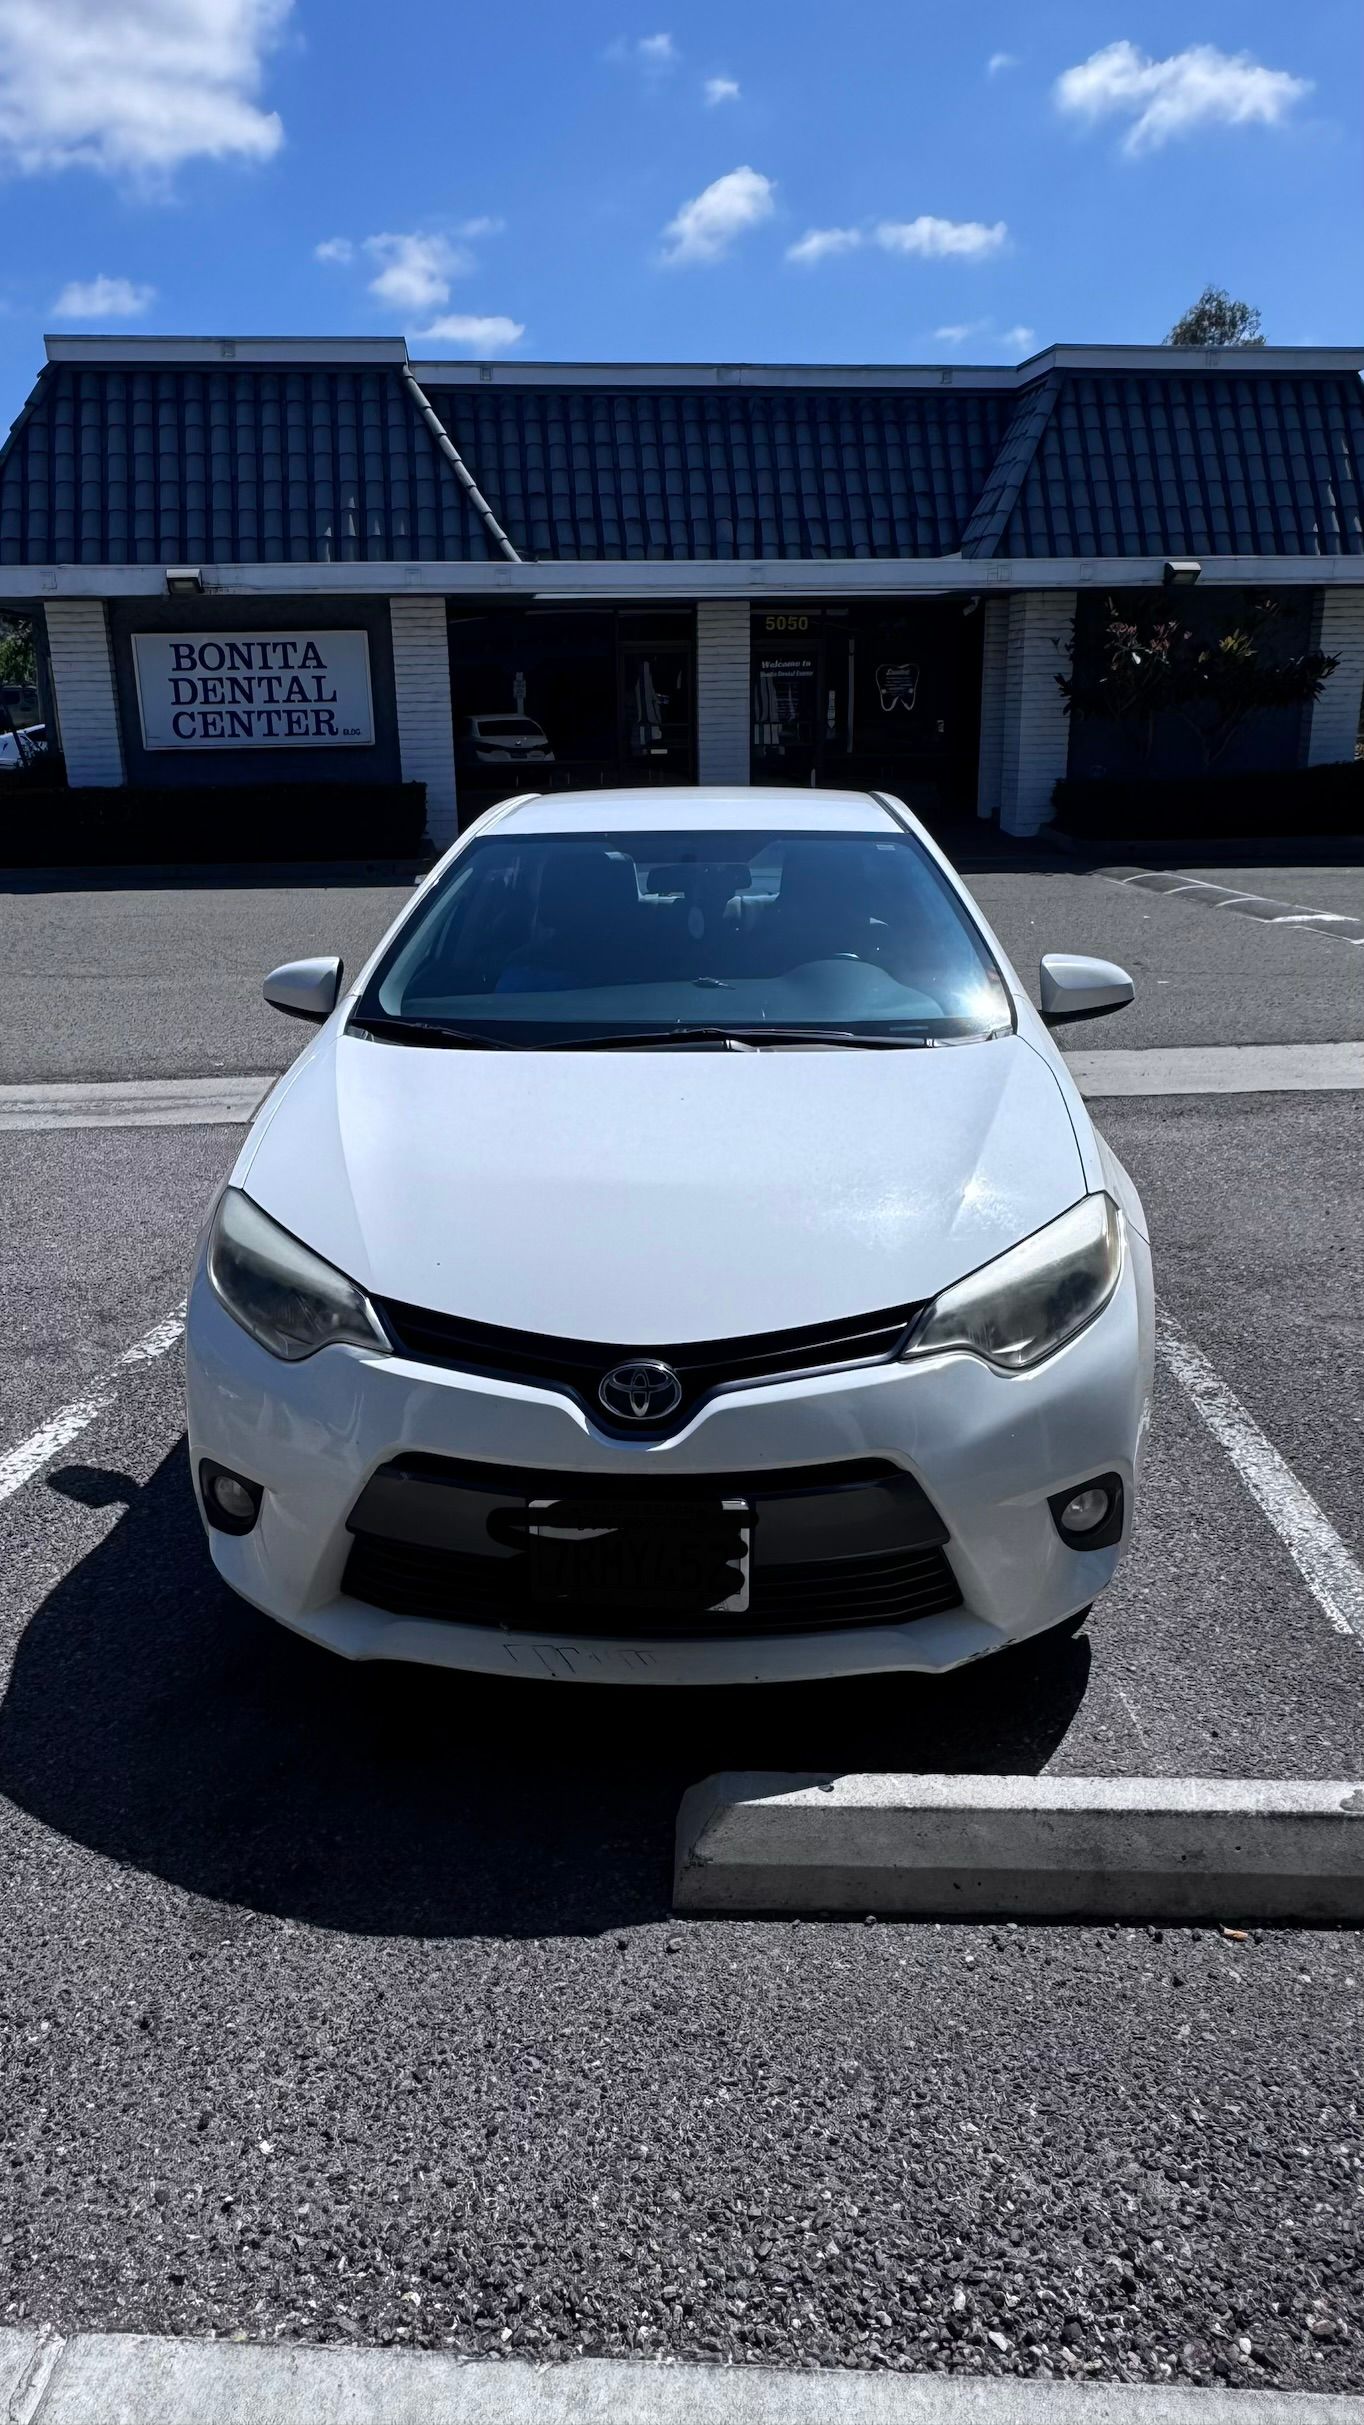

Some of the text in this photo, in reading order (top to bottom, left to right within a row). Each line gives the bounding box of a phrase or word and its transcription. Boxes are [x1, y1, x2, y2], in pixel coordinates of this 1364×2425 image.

[765, 616, 809, 631] 5050
[169, 641, 328, 671] BONITA
[761, 660, 800, 669] Welcome
[168, 675, 338, 705] DENTAL
[172, 709, 339, 739] CENTER
